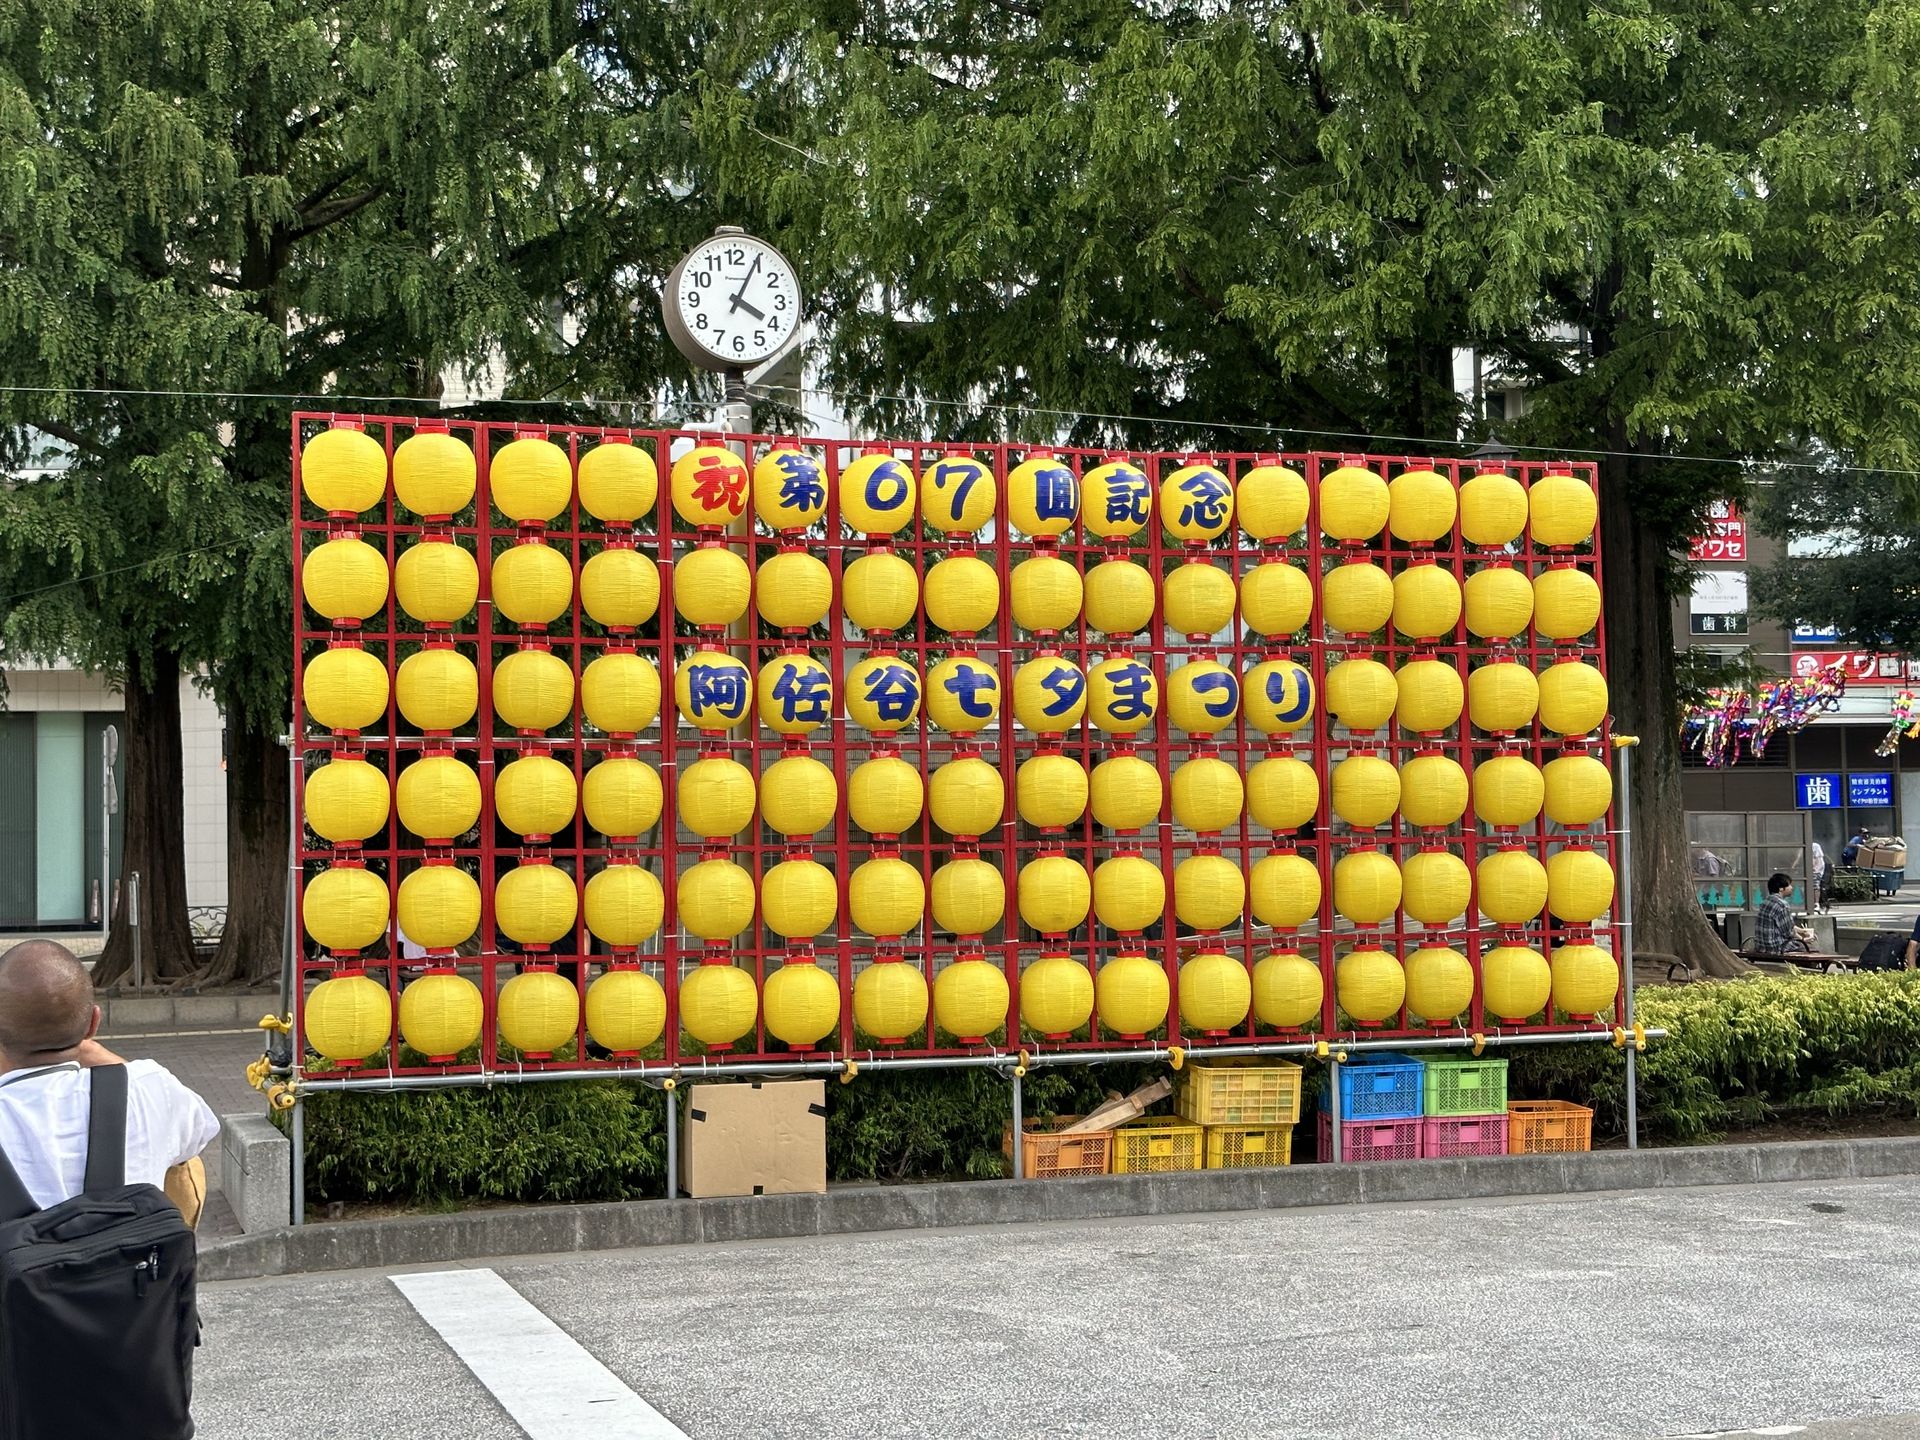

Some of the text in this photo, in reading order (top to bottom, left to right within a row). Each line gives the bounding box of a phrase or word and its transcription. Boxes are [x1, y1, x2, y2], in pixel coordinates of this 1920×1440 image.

[705, 255, 722, 272] 11
[724, 249, 745, 266] 12
[690, 271, 712, 288] 10
[767, 272, 779, 289] 2
[687, 291, 701, 308] 9
[774, 294, 787, 311] 3
[696, 313, 709, 330] 8
[767, 315, 780, 332] 4
[712, 329, 726, 346] 7
[732, 335, 745, 352] 6
[753, 330, 766, 347] 5
[1702, 615, 1738, 631] 歯科
[687, 664, 1311, 723] 阿佐谷七夕まつり
[1805, 776, 1832, 806] 歯
[1852, 787, 1888, 795] インプラント
